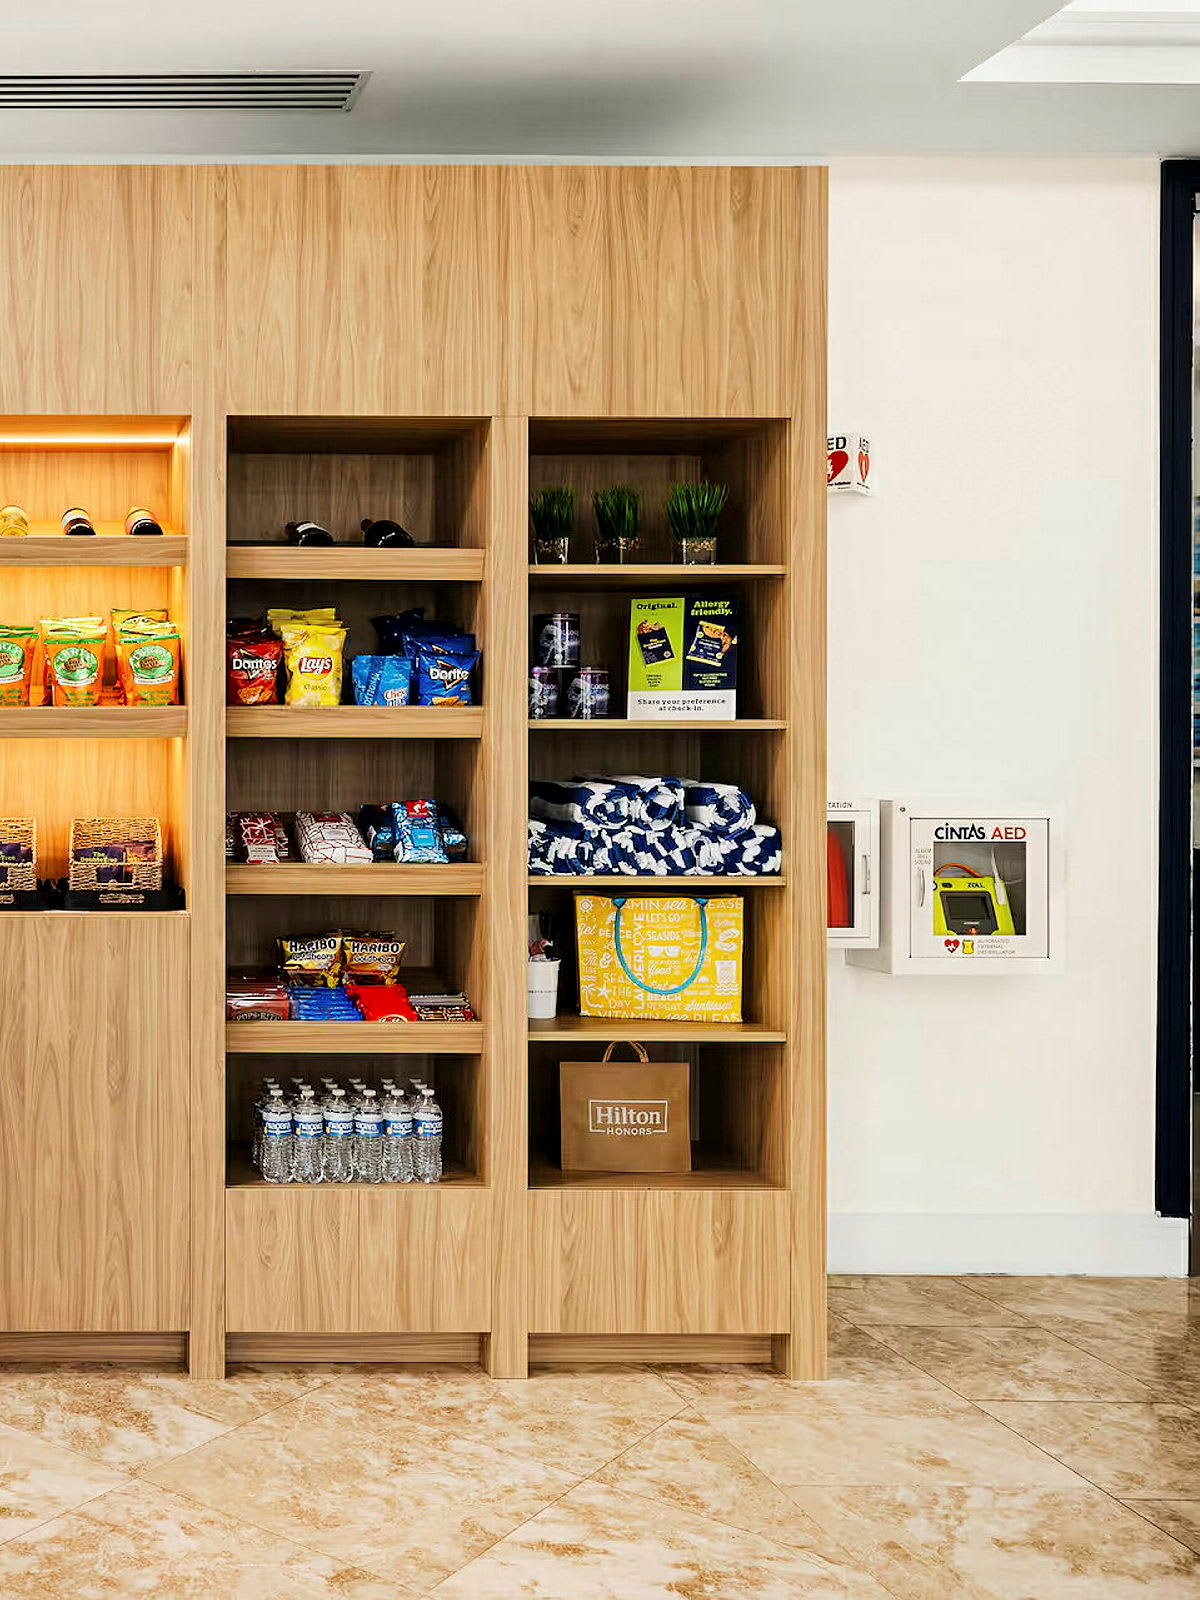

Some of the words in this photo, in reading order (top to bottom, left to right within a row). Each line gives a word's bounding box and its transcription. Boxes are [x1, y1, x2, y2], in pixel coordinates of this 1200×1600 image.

[827, 436, 846, 450] ED
[637, 602, 678, 610] Original.
[694, 601, 730, 611] Allergy
[232, 658, 277, 671] Doritos
[429, 667, 470, 680] Dorito
[991, 827, 1026, 839] AED
[600, 899, 660, 910] VIAMIN
[691, 899, 742, 909] PEASE
[289, 938, 337, 953] HARIBO
[351, 942, 401, 953] HARIBO
[596, 1106, 661, 1125] Hilton
[606, 1127, 652, 1136] HONORS
